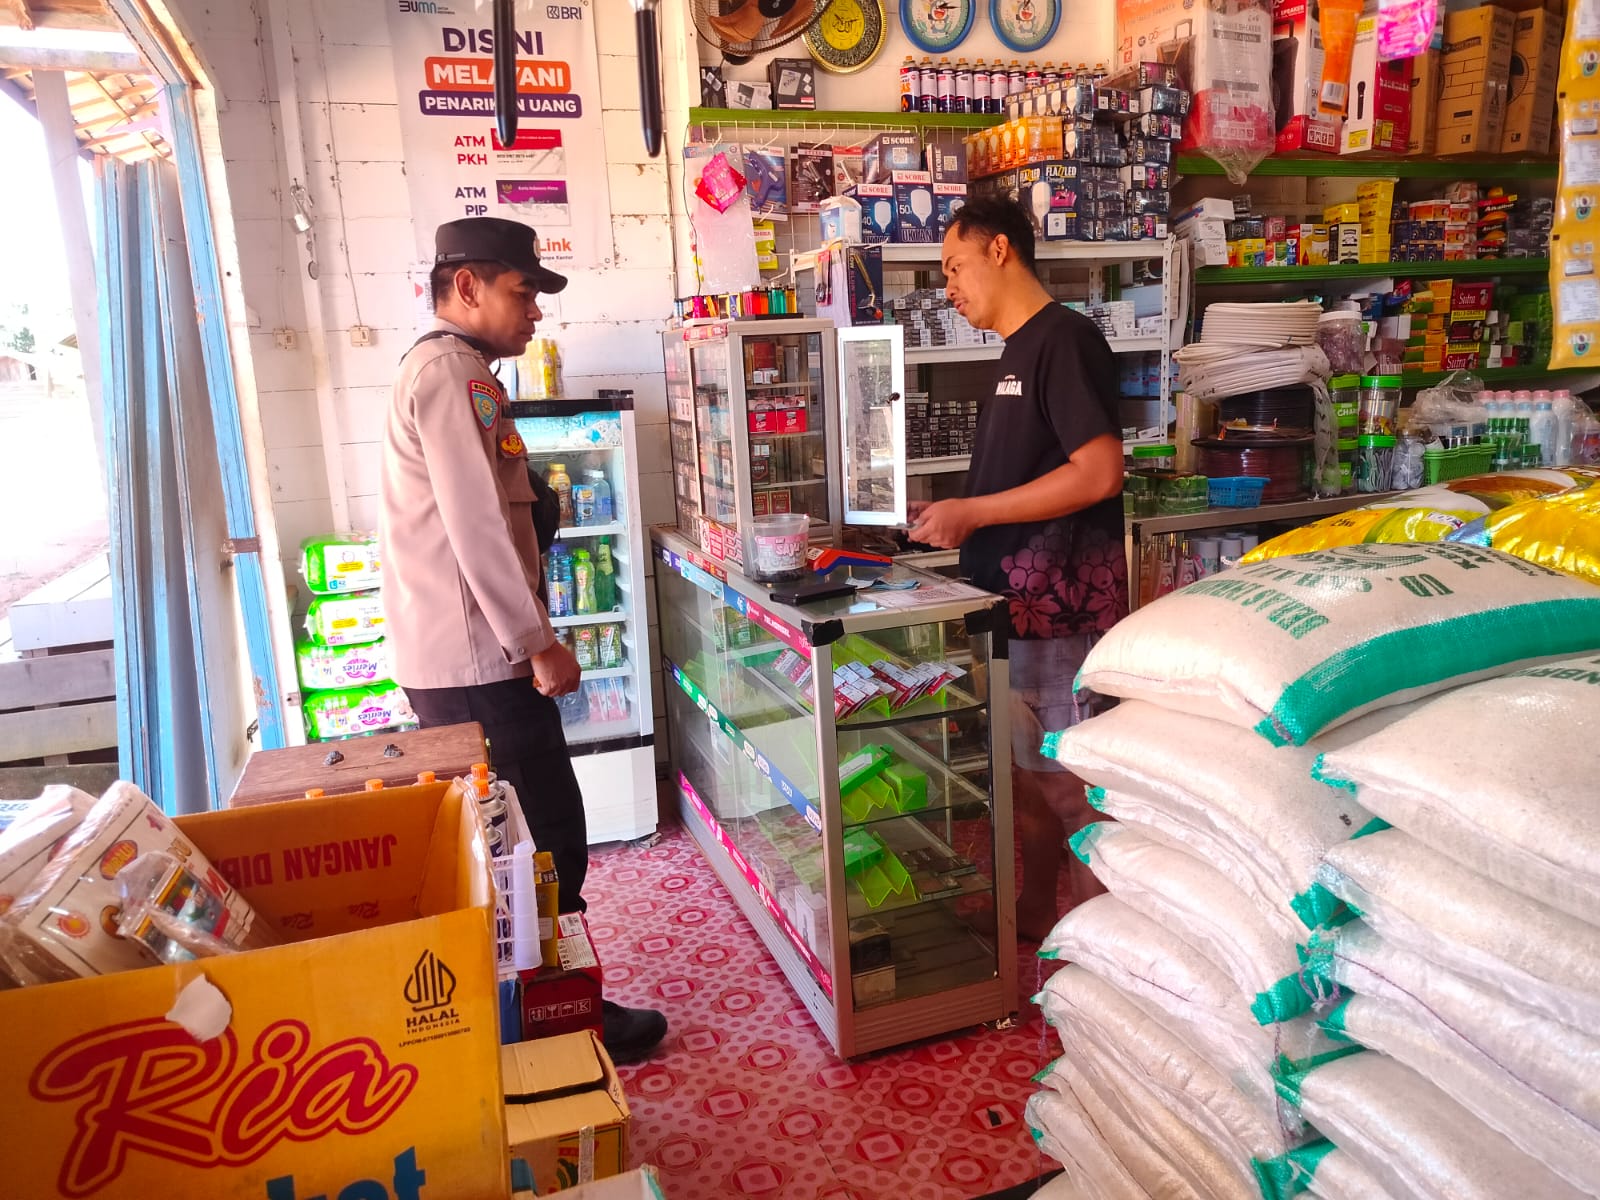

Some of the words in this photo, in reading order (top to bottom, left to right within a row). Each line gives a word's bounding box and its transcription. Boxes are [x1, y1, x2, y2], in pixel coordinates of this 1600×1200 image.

[561, 6, 582, 20] BRI
[442, 27, 544, 56] DISNI
[433, 63, 565, 88] MELAANI
[424, 96, 526, 113] PENARIKN
[529, 98, 577, 113] UANG
[454, 135, 486, 148] ATM
[890, 136, 916, 145] SCORE
[457, 153, 488, 166] PKH
[904, 174, 927, 182] SCORE
[1045, 164, 1077, 178] FLAZZLED
[454, 186, 487, 199] ATM
[868, 186, 889, 194] SCORE
[943, 185, 962, 193] SCORE
[465, 205, 488, 217] PIP
[1446, 355, 1467, 369] Sutra
[1240, 588, 1331, 641] BERAS
[342, 662, 378, 674] Merries
[357, 709, 392, 722] Merries
[283, 833, 398, 882] JANGAN
[217, 852, 273, 889] DIB
[347, 898, 380, 921] Ria
[282, 910, 315, 931] Ria
[406, 1007, 459, 1029] HALAL
[407, 1018, 461, 1035] INDONESIA
[27, 1016, 420, 1199] Ria
